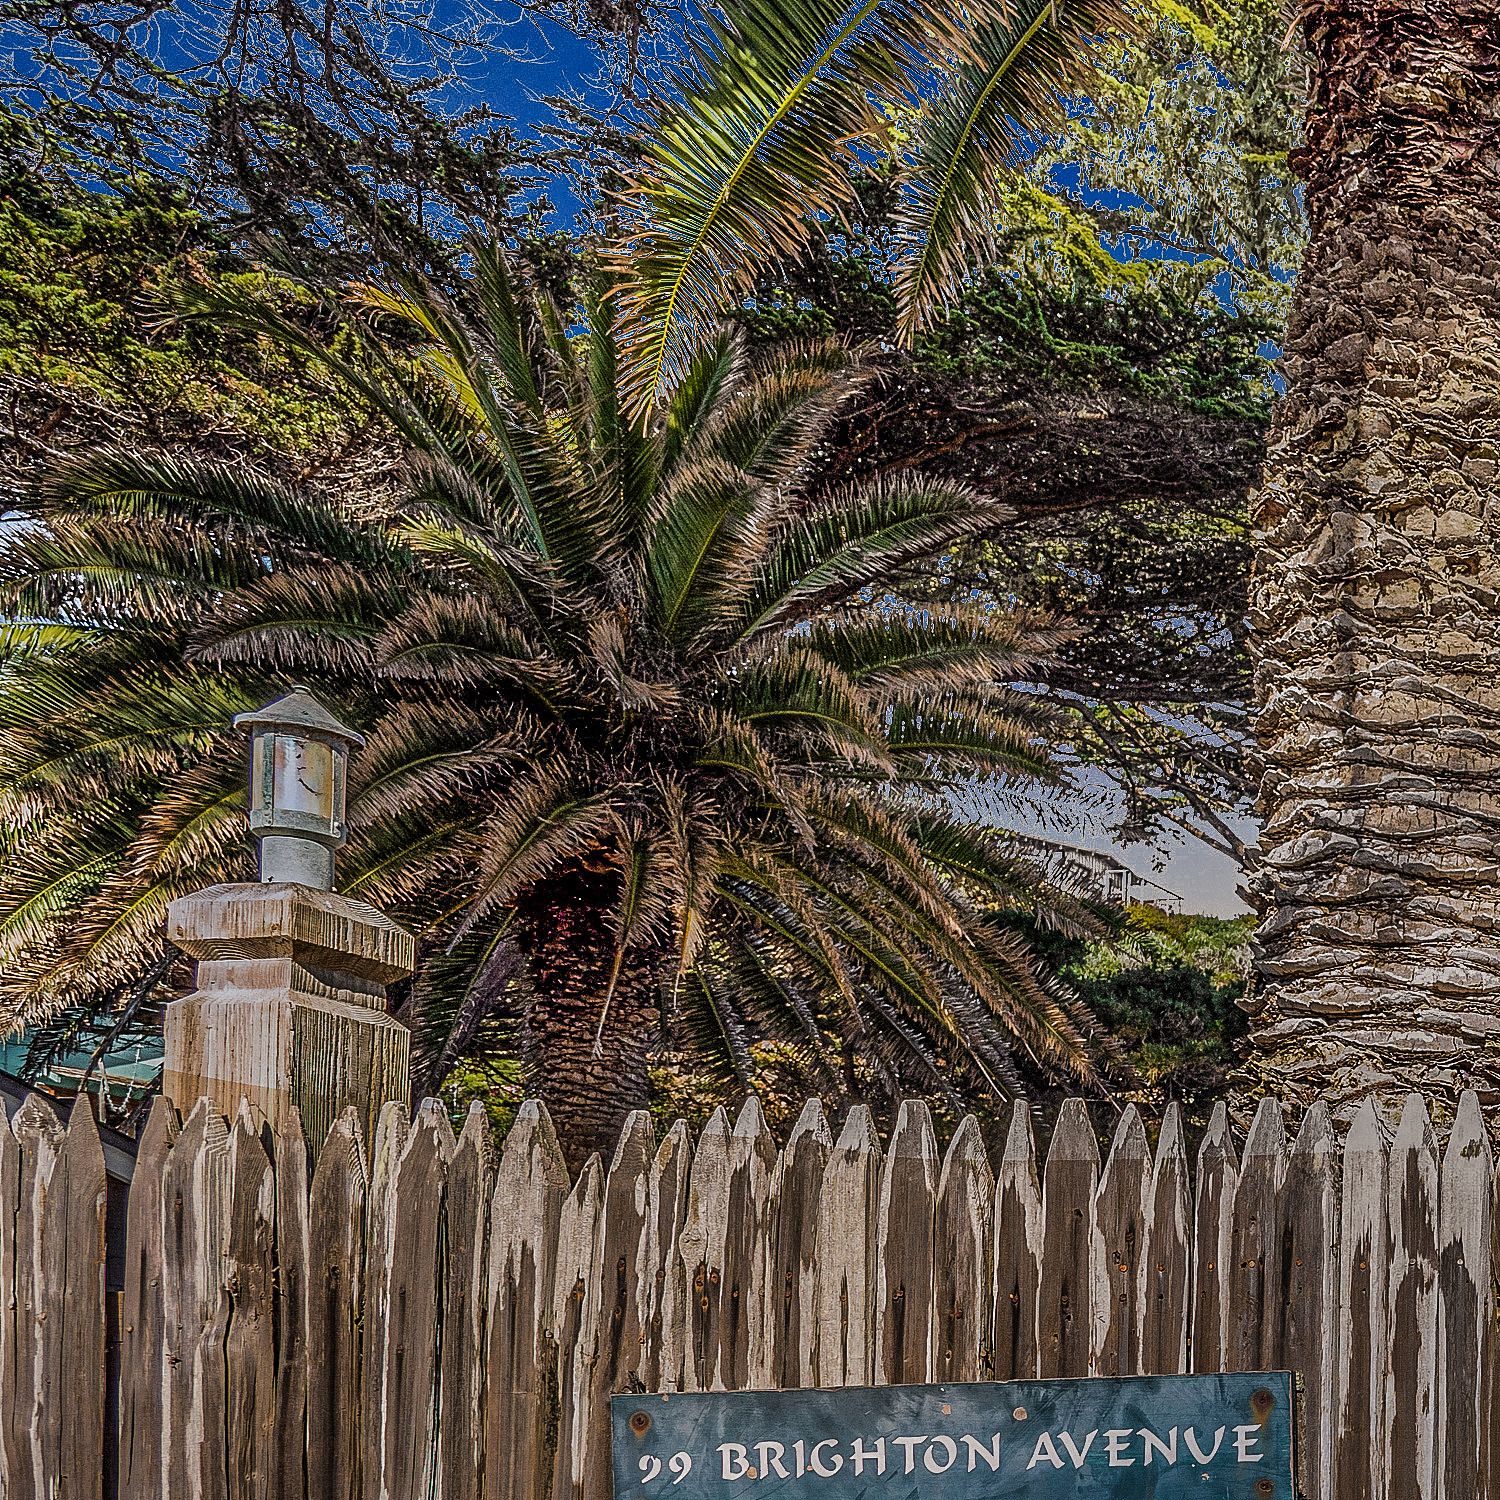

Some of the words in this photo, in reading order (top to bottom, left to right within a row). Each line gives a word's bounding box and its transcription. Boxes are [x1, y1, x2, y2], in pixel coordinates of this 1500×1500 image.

[639, 1450, 693, 1486] 99
[715, 1431, 1001, 1481] BRIGHTON
[1025, 1422, 1264, 1471] AVENUE
